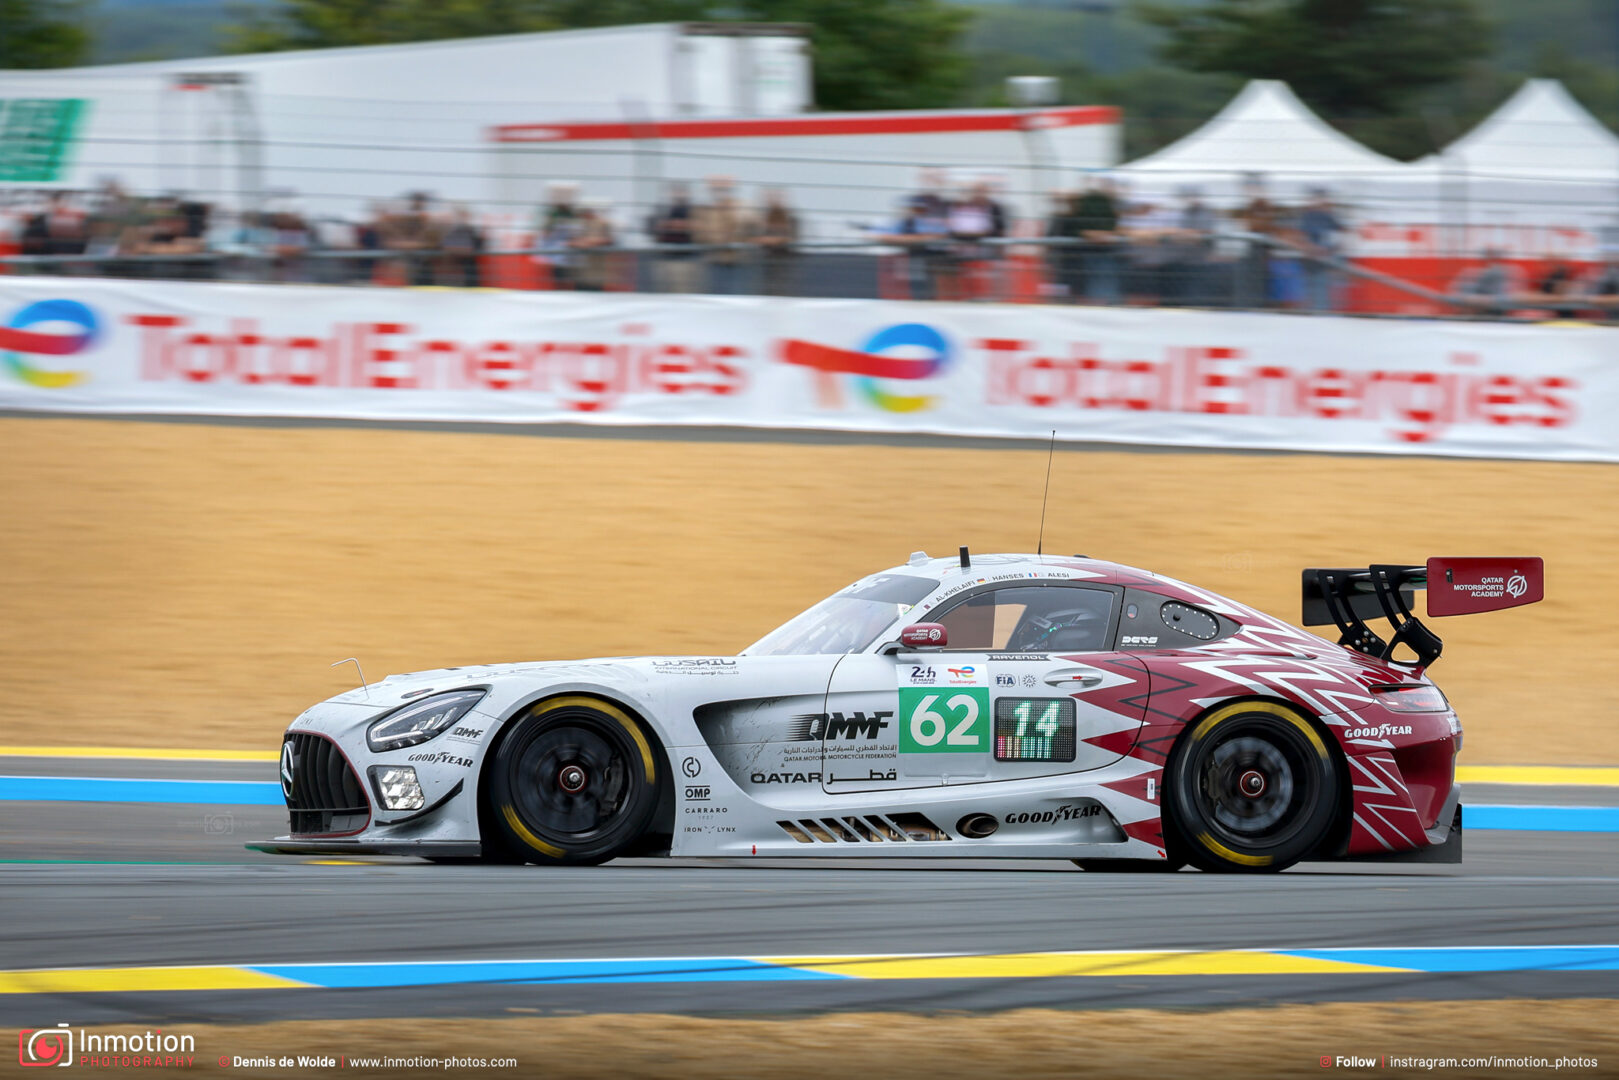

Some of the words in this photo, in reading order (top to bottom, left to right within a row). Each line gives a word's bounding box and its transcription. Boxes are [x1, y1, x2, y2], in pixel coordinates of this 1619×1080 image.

[122, 314, 751, 412] TotalEnergies
[970, 339, 1578, 442] TotalEnergies
[992, 573, 1024, 582] HANSES
[786, 711, 894, 741] QMMF
[910, 694, 980, 747] 62
[1014, 700, 1060, 737] 14
[1344, 723, 1412, 738] GOODYEAR
[408, 752, 473, 767] GOODYEAR
[751, 772, 822, 784] QATAR
[685, 788, 711, 798] OMP
[1004, 804, 1102, 825] GOODYEAR
